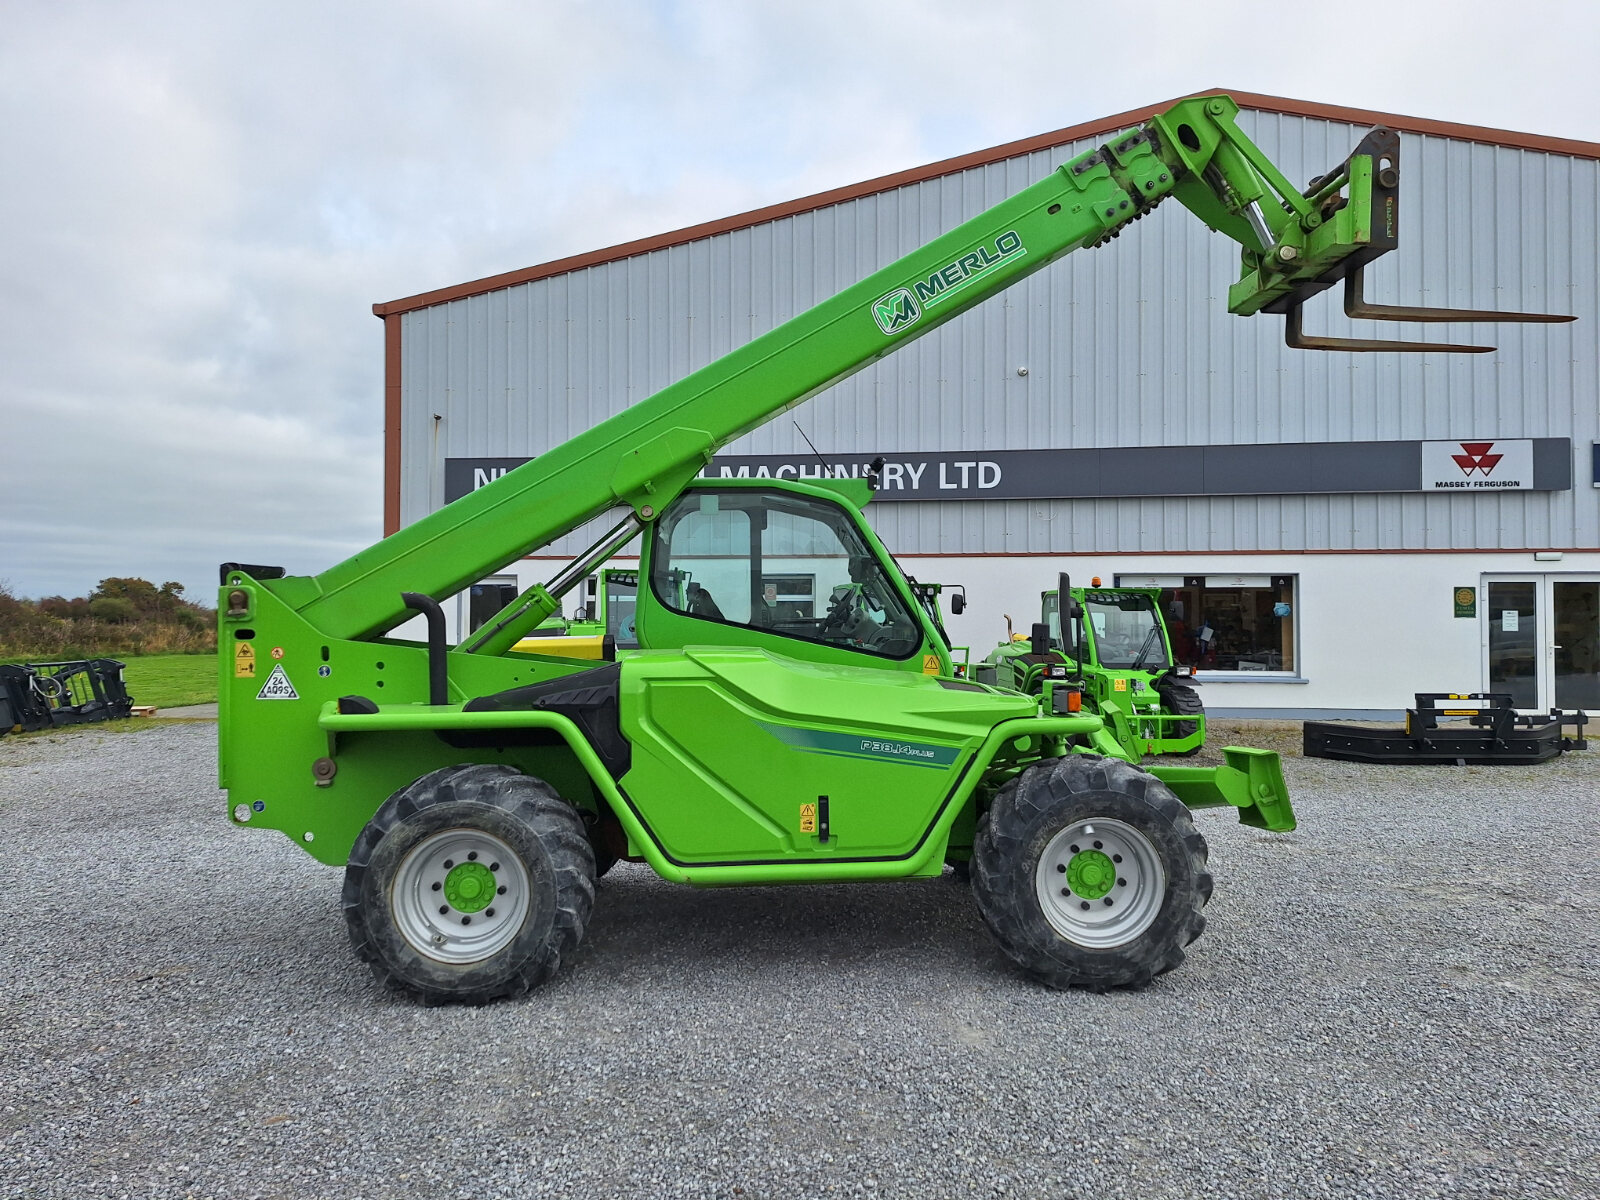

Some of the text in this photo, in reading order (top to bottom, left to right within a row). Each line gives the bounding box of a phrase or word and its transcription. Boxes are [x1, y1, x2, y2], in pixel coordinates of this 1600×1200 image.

[913, 230, 1021, 302] MERLO
[939, 461, 1002, 489] LTD
[1473, 480, 1520, 488] FERGUSON
[273, 677, 283, 685] 24
